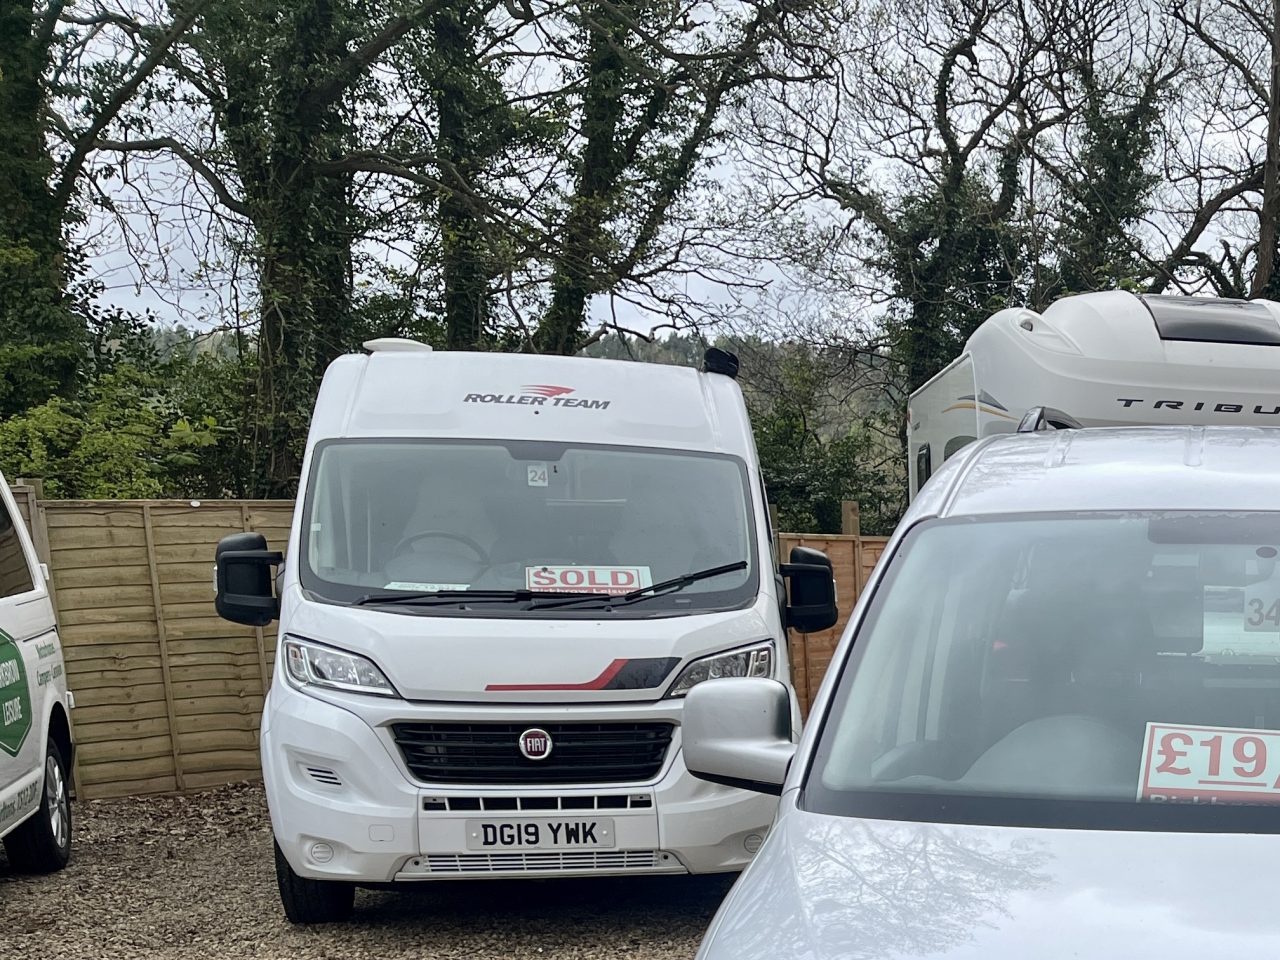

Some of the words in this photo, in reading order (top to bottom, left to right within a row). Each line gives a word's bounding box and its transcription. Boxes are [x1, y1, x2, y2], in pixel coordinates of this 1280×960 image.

[463, 394, 547, 406] ROLLER
[552, 397, 611, 410] TEAM
[529, 469, 547, 483] 24
[533, 569, 635, 586] SOLD
[526, 737, 546, 752] FIAT
[481, 823, 540, 846] DG19
[548, 822, 598, 845] YWK
